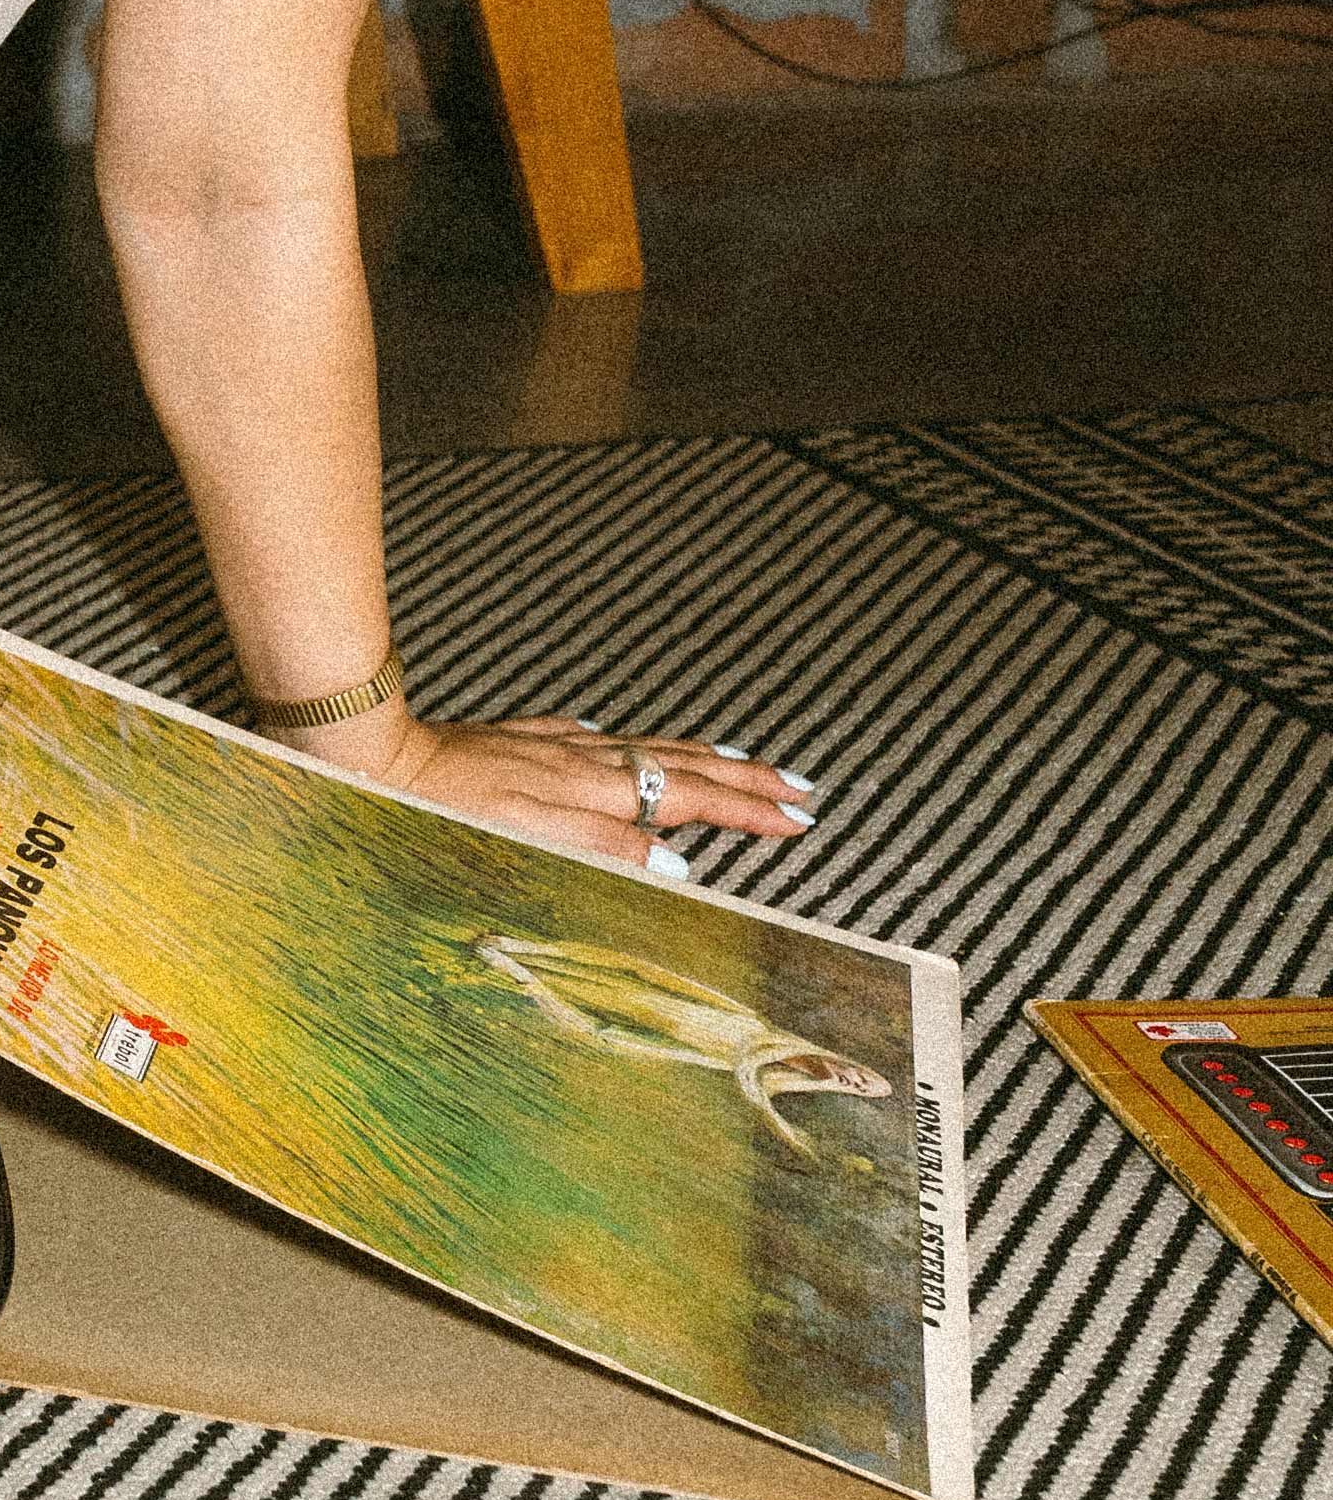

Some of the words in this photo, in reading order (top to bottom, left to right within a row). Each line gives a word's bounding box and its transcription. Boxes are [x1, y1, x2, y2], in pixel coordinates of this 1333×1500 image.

[16, 811, 75, 869] LOS
[38, 940, 62, 962] LO
[18, 959, 53, 1002] MEJOR
[7, 998, 33, 1022] DE
[113, 1028, 143, 1070] trébol
[916, 1094, 944, 1196] MONAURAL
[920, 1220, 946, 1311] ESTEREO
